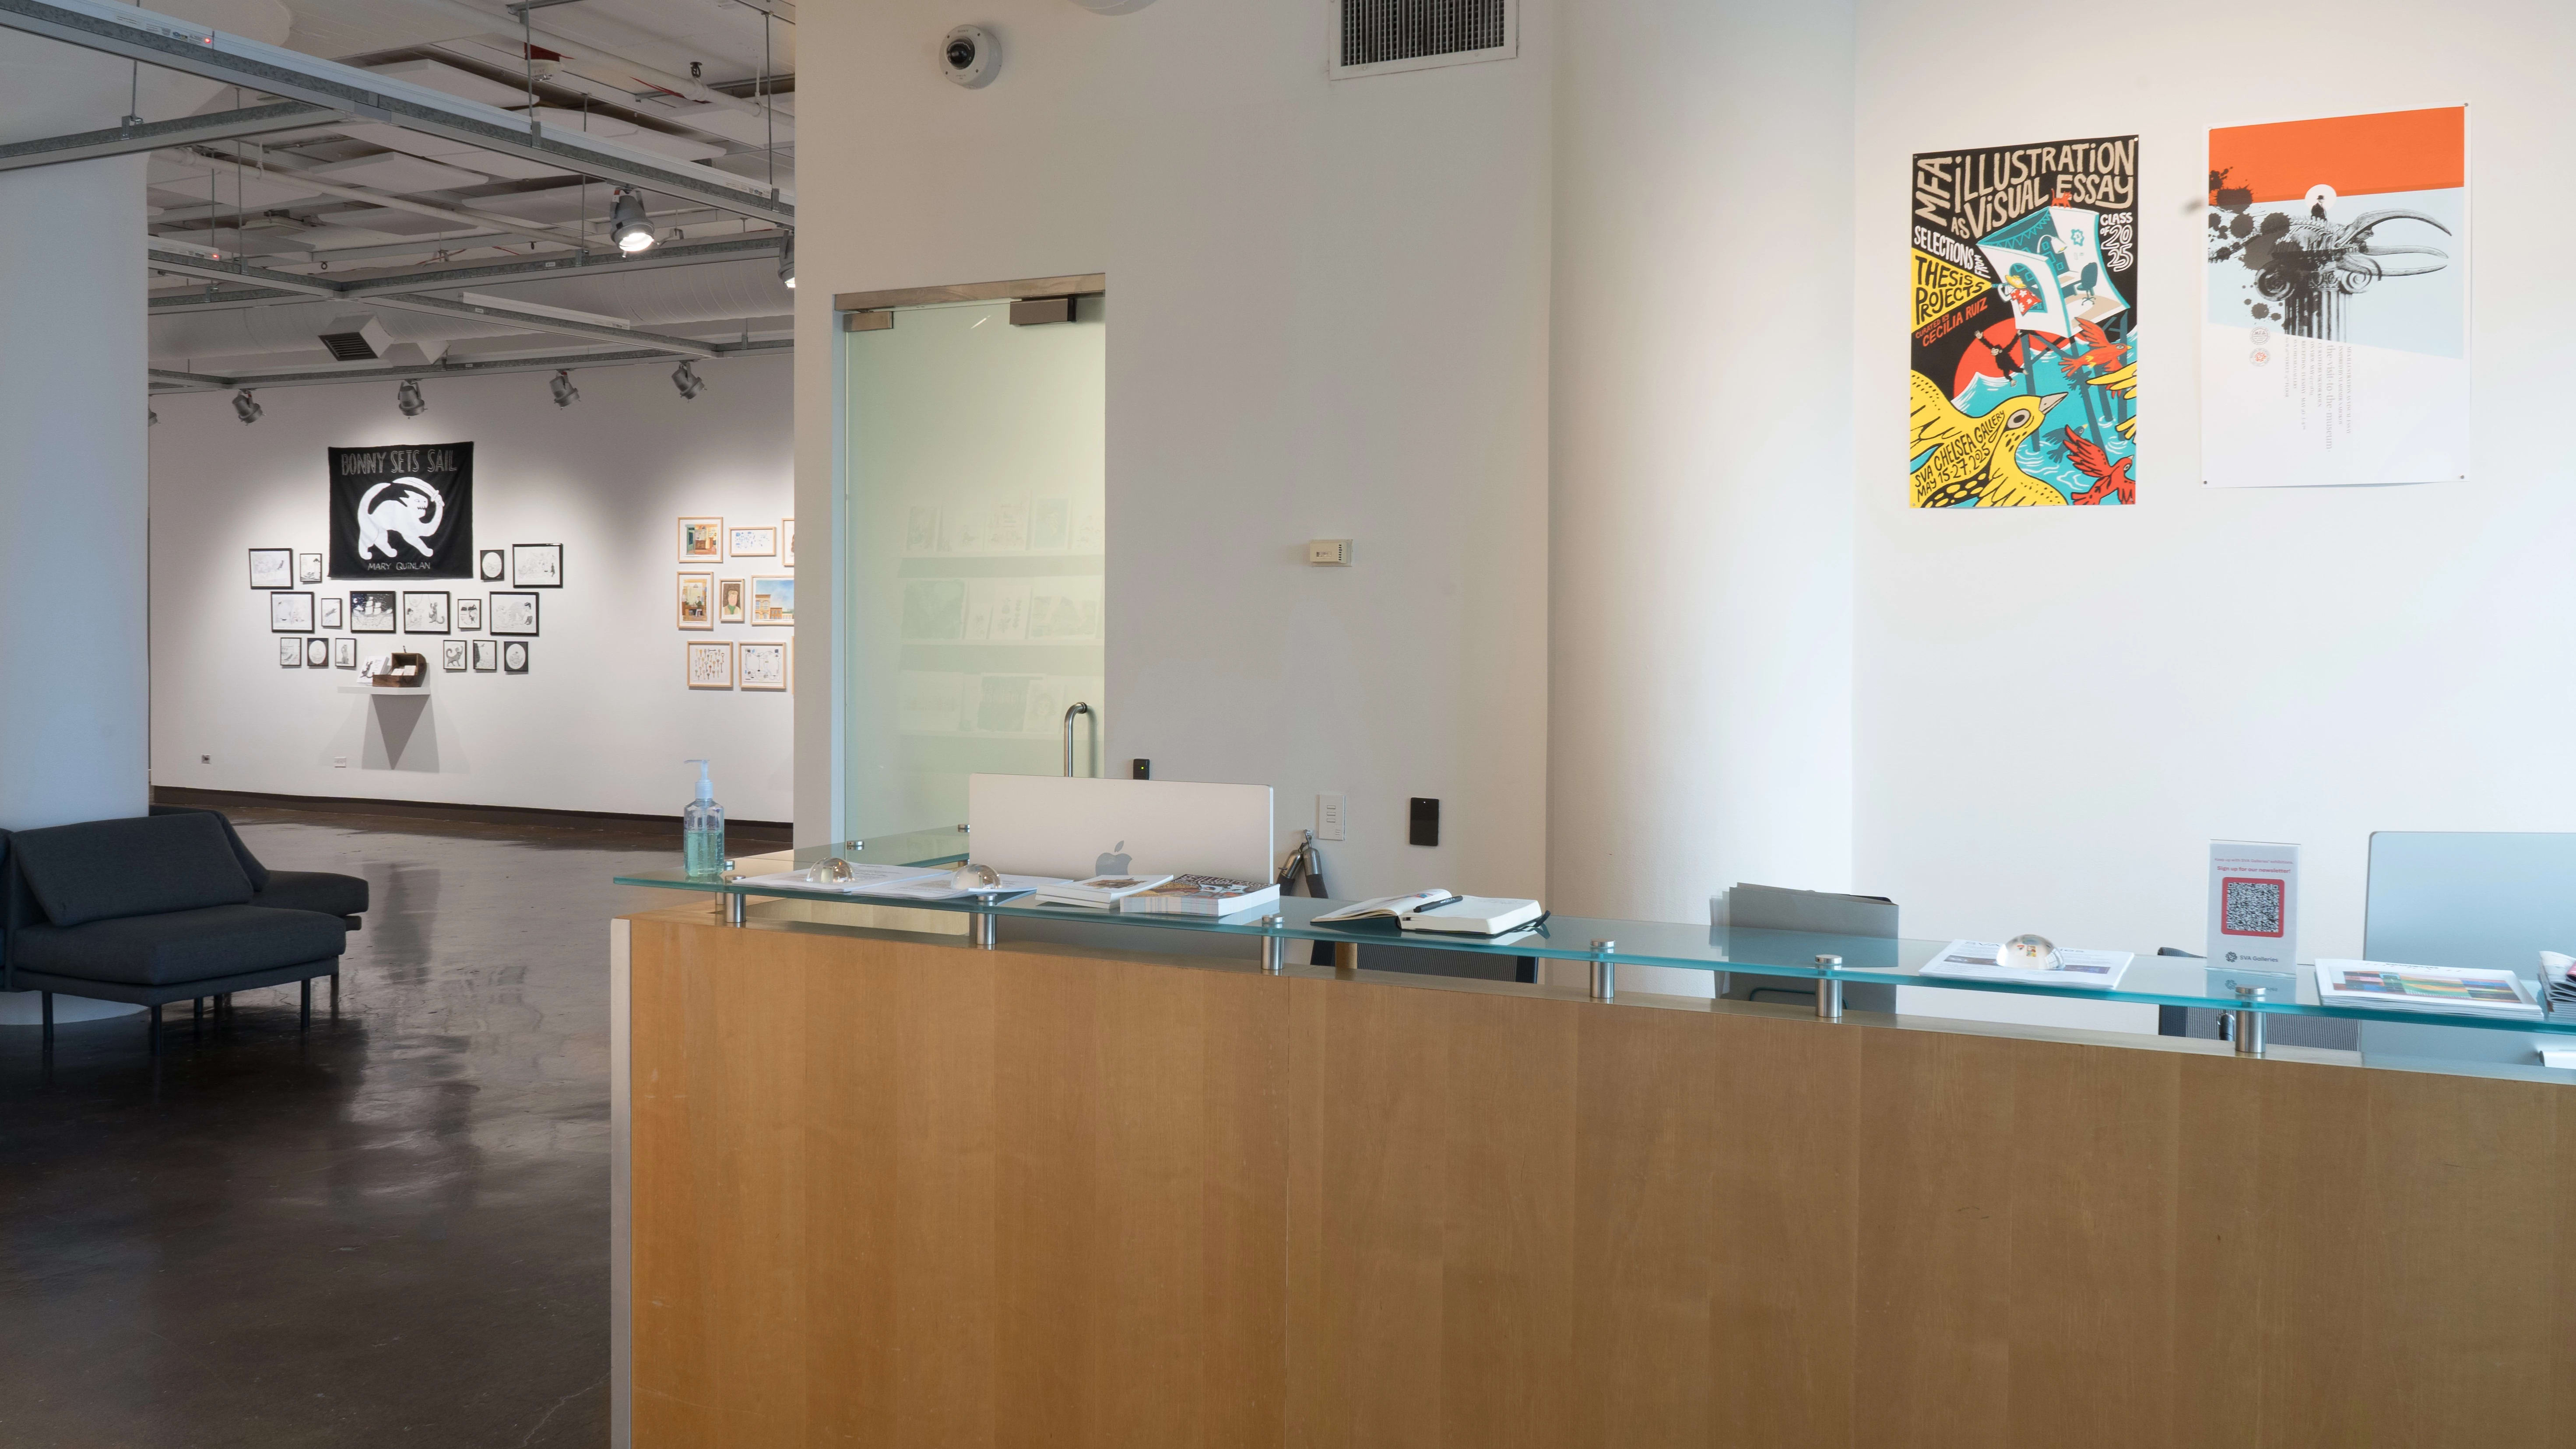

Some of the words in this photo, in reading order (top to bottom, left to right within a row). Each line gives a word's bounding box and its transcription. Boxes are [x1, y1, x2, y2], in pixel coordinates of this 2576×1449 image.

[1915, 157, 1953, 227] MFA
[1951, 217, 1970, 239] AS
[2100, 212, 2133, 226] CLASS
[2100, 228, 2109, 237] OF
[1914, 225, 1975, 270] SELECTIONS
[1974, 254, 1992, 279] FROM
[1915, 282, 1985, 325] PROJECTS
[1915, 319, 1941, 339] CURATED
[1942, 314, 1950, 323] BY
[1922, 311, 1964, 347] CECILIA
[1965, 297, 1988, 320] RUIZ
[341, 452, 387, 476] BONNY
[390, 450, 420, 473] SETS
[427, 449, 458, 473] SAIL
[1915, 465, 1933, 488] SVA
[1934, 433, 1977, 471] CHELSEA
[1974, 410, 2005, 444] GALLERY
[1917, 478, 1937, 502] MAY
[1969, 442, 1990, 470] 2025
